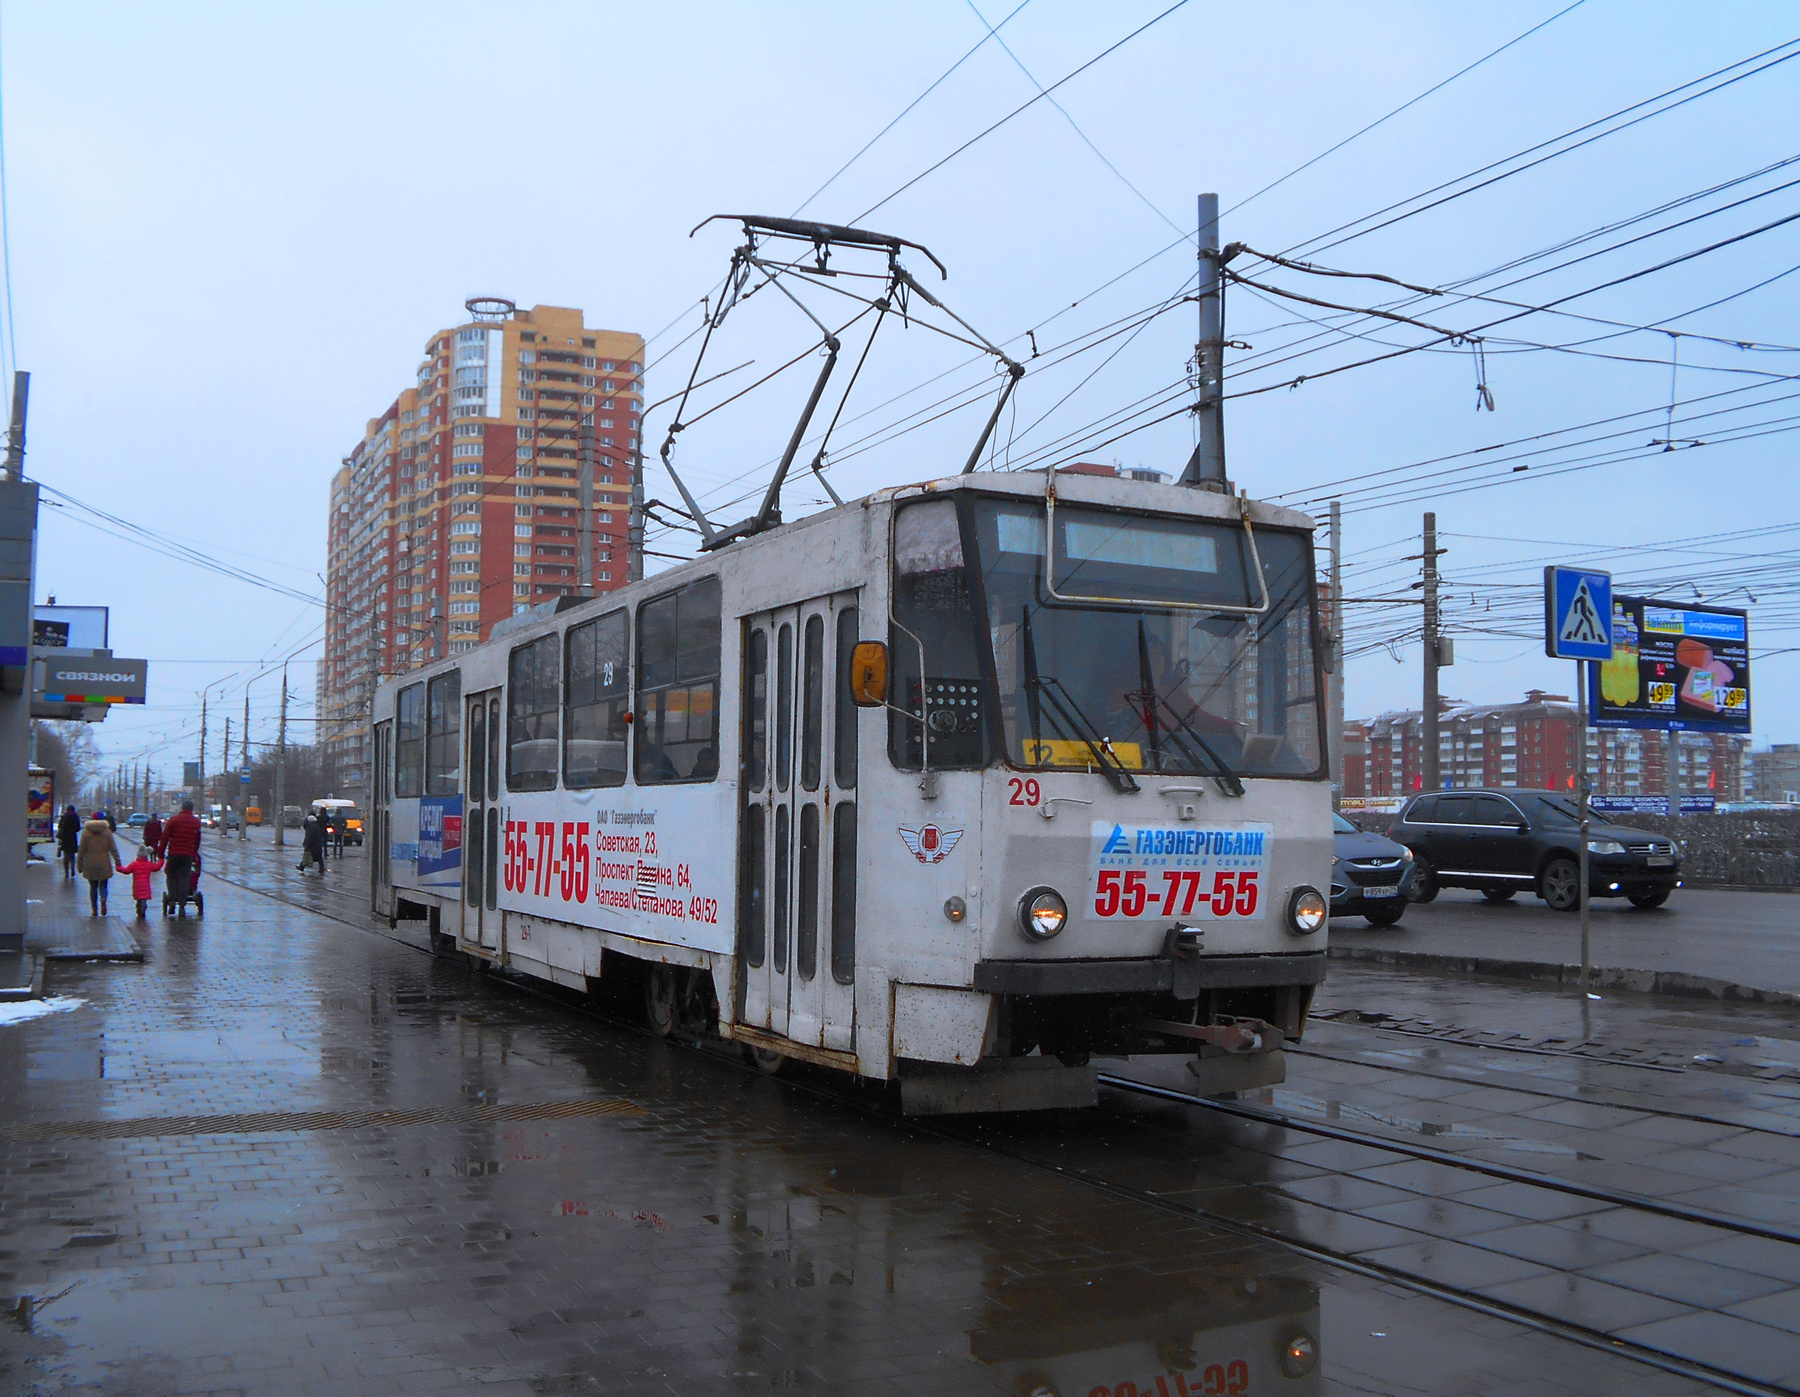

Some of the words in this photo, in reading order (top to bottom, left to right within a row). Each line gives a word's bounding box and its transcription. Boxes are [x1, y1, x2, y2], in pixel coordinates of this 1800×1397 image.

[55, 671, 135, 683] СВЯЗНОЙ
[603, 661, 614, 686] 29
[1029, 744, 1054, 765] 12
[1008, 777, 1041, 807] 29
[597, 810, 608, 825] ОАО
[596, 829, 642, 857] Советская,
[645, 831, 658, 859] 23,
[1135, 829, 1264, 856] ГАЗЭНЕРГОБАНК
[504, 821, 590, 904] 55-77-55
[595, 857, 635, 883] Проспект
[677, 863, 692, 893] 64,
[1100, 858, 1134, 866] БАНК
[1143, 858, 1167, 866] ДЛЯ
[1177, 858, 1208, 866] ВСЕЙ
[1217, 859, 1262, 867] СЕМЬИ!
[1095, 870, 1259, 917] 55-77-55
[689, 896, 718, 924] 49/52
